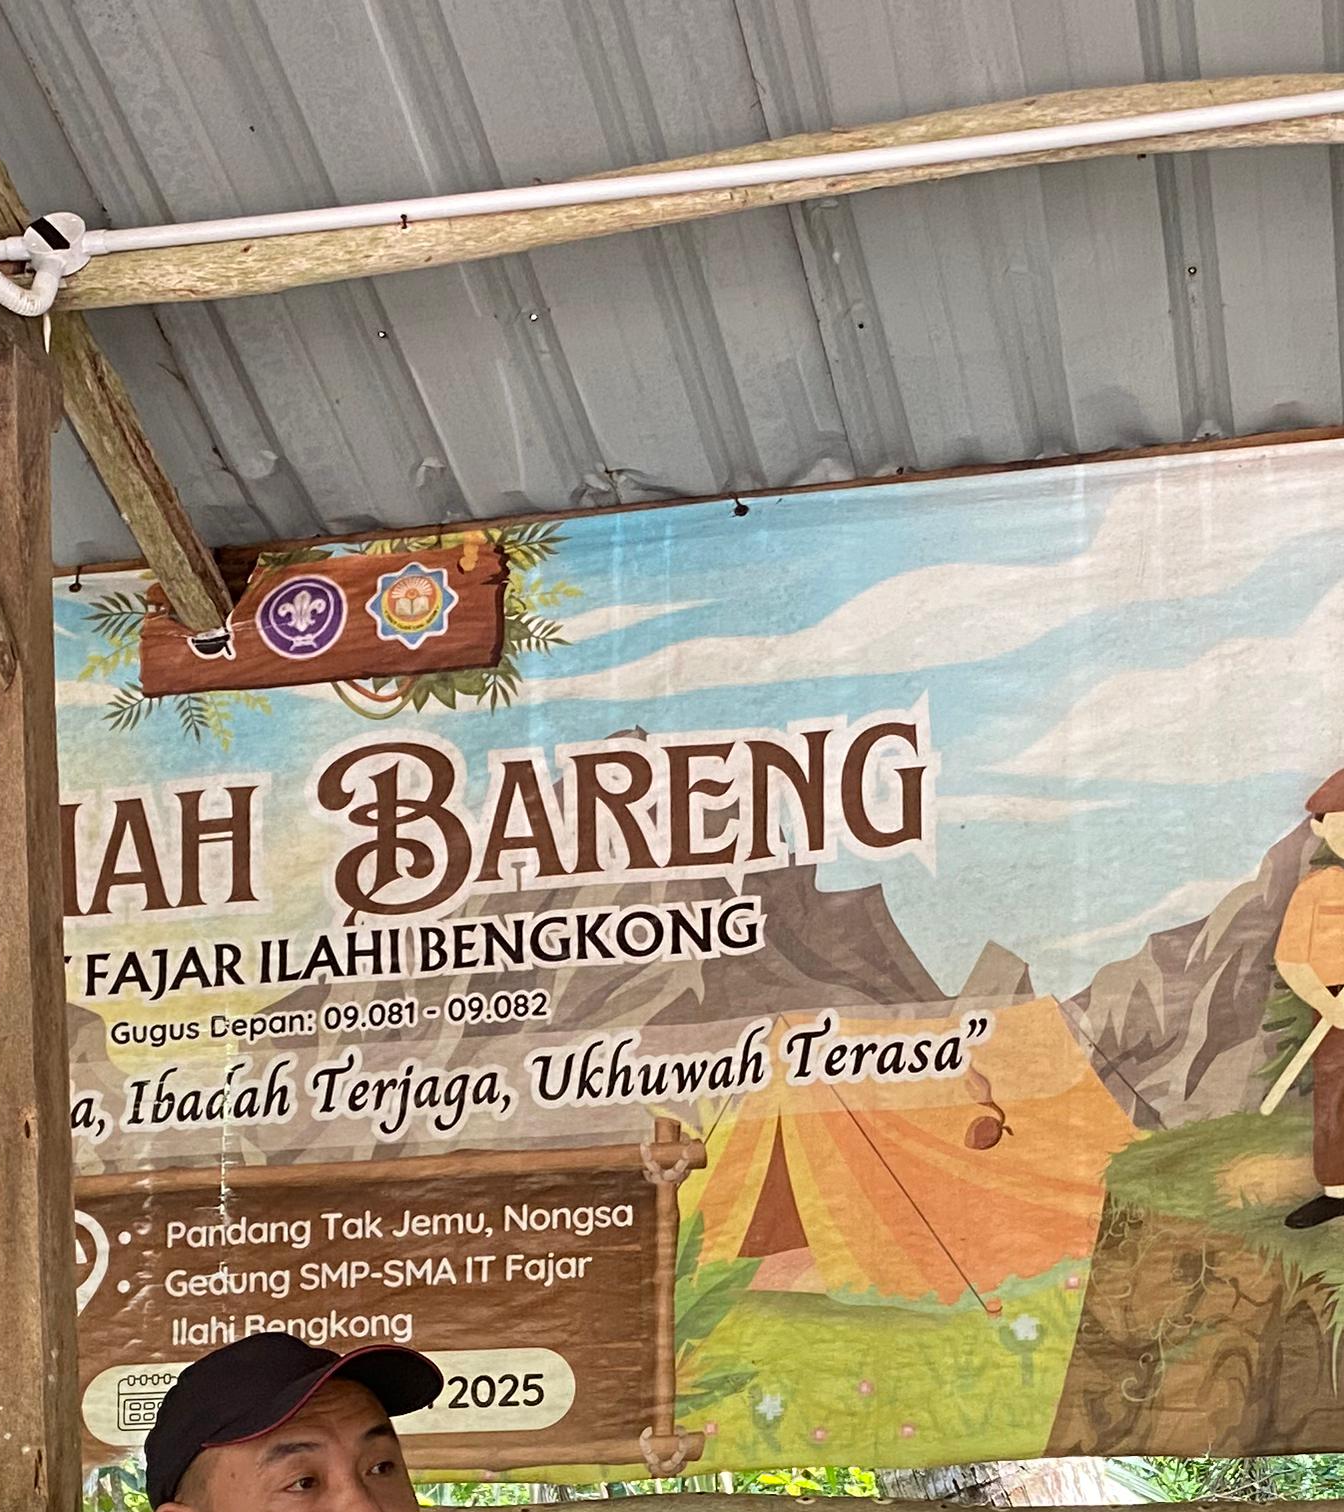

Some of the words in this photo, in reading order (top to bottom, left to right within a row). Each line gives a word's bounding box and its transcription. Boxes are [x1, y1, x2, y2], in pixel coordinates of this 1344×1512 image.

[316, 721, 927, 920] BARENG
[86, 944, 245, 1000] FAJAR
[260, 929, 401, 983] ILAHI
[420, 903, 757, 972] BENGKONG
[111, 1022, 199, 1047] Gugus
[211, 1013, 316, 1044] Depan:
[325, 1002, 414, 1029] 09.081
[448, 993, 546, 1021] 09.082
[126, 1061, 290, 1125] Ibadah
[313, 1058, 512, 1133] Terjaga,
[532, 1027, 764, 1101] Ukhuwah
[167, 1217, 310, 1248] Pandang
[321, 1211, 383, 1240] Tak
[392, 1210, 493, 1237] Jemu,
[505, 1204, 633, 1236] Nongsa
[165, 1264, 291, 1299] Gedung
[300, 1258, 456, 1290] SMP-SMA
[466, 1256, 496, 1283] IT
[506, 1253, 592, 1287] Fajar
[173, 1316, 234, 1345] Ilahi
[448, 1374, 544, 1408] 2025
